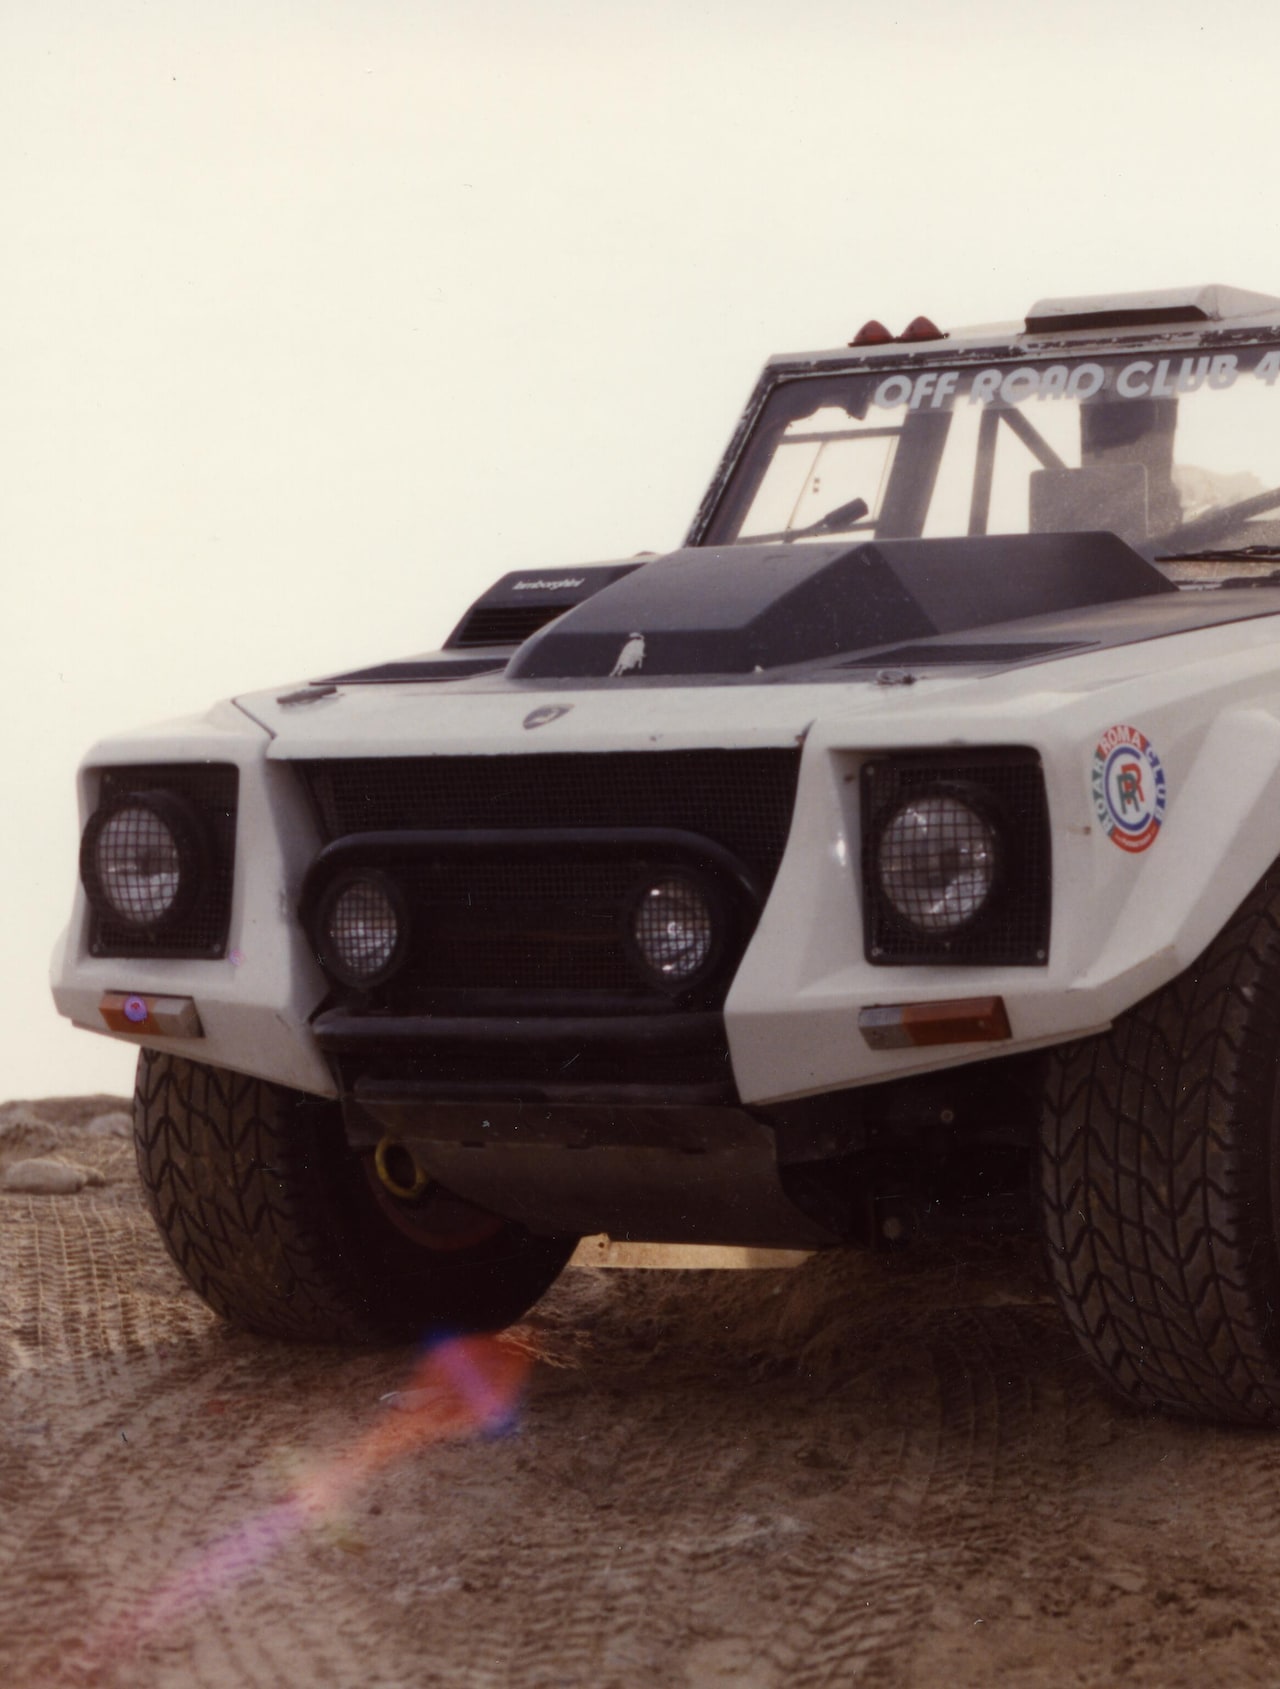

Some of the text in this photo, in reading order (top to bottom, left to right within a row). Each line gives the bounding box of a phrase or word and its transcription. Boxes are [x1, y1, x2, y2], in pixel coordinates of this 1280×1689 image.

[873, 371, 959, 410] OFF
[969, 362, 1107, 405] ROAD
[1115, 352, 1240, 399] CLUB
[1099, 725, 1144, 757] ROMA
